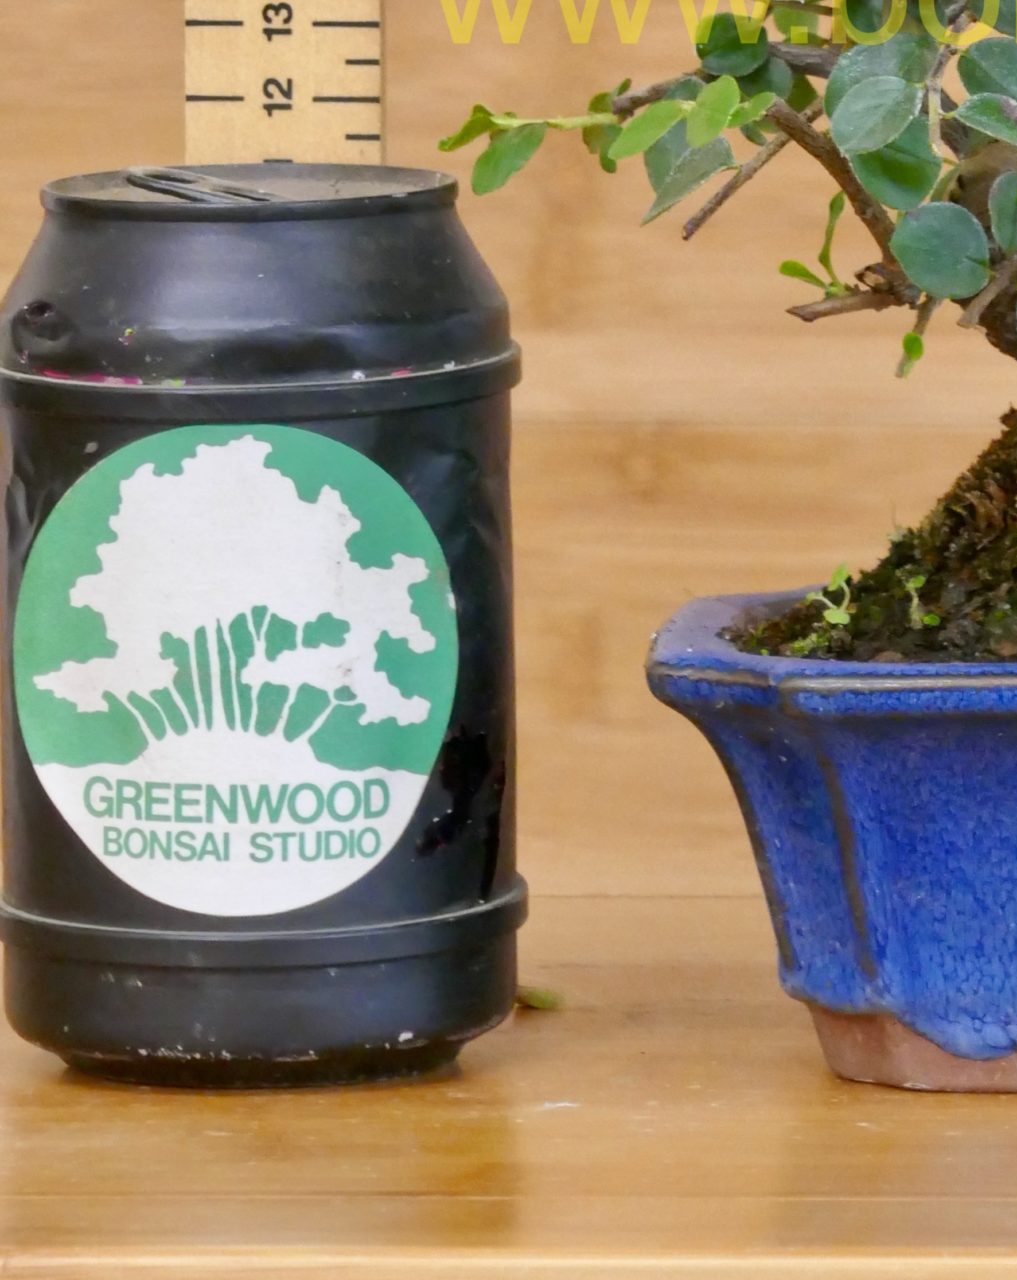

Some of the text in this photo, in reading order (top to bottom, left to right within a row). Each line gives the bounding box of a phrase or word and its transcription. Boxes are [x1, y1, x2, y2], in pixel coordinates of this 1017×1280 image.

[262, 2, 293, 42] 13
[263, 78, 293, 117] 12
[83, 776, 390, 825] GREENWOOD
[102, 826, 382, 863] BONSAI STUDIO
